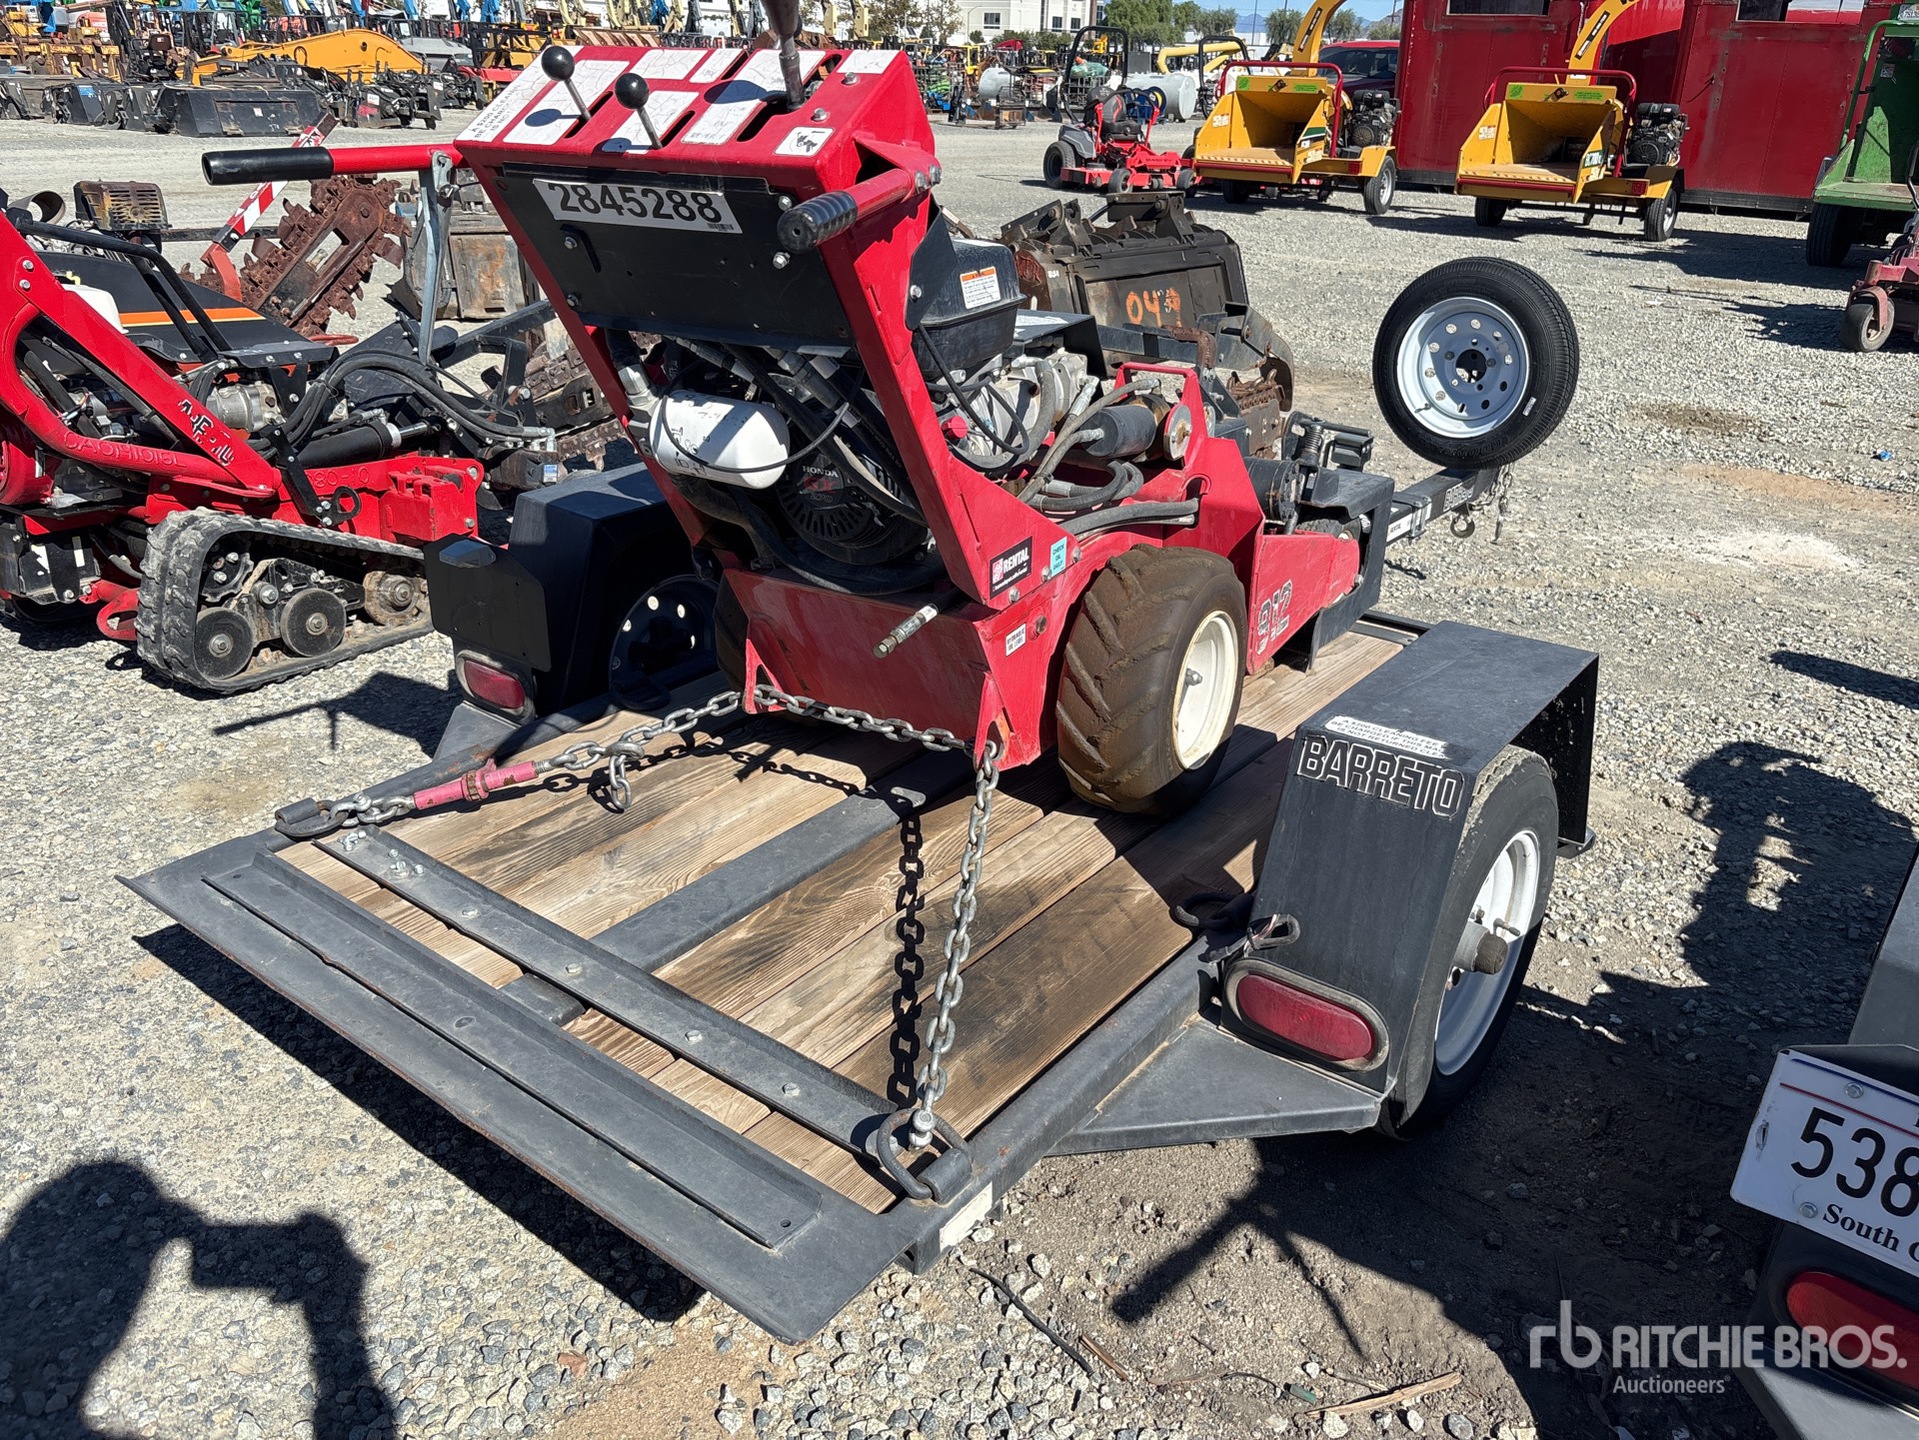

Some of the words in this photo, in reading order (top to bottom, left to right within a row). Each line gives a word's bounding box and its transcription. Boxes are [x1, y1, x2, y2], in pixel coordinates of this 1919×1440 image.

[548, 182, 722, 223] 2845288
[802, 465, 839, 478] HONDA
[1003, 547, 1030, 574] RENTAL
[1345, 725, 1391, 739] CHARGED
[1372, 725, 1419, 742] CLEANING
[1296, 734, 1465, 818] BARRETO
[1823, 1203, 1900, 1254] South
